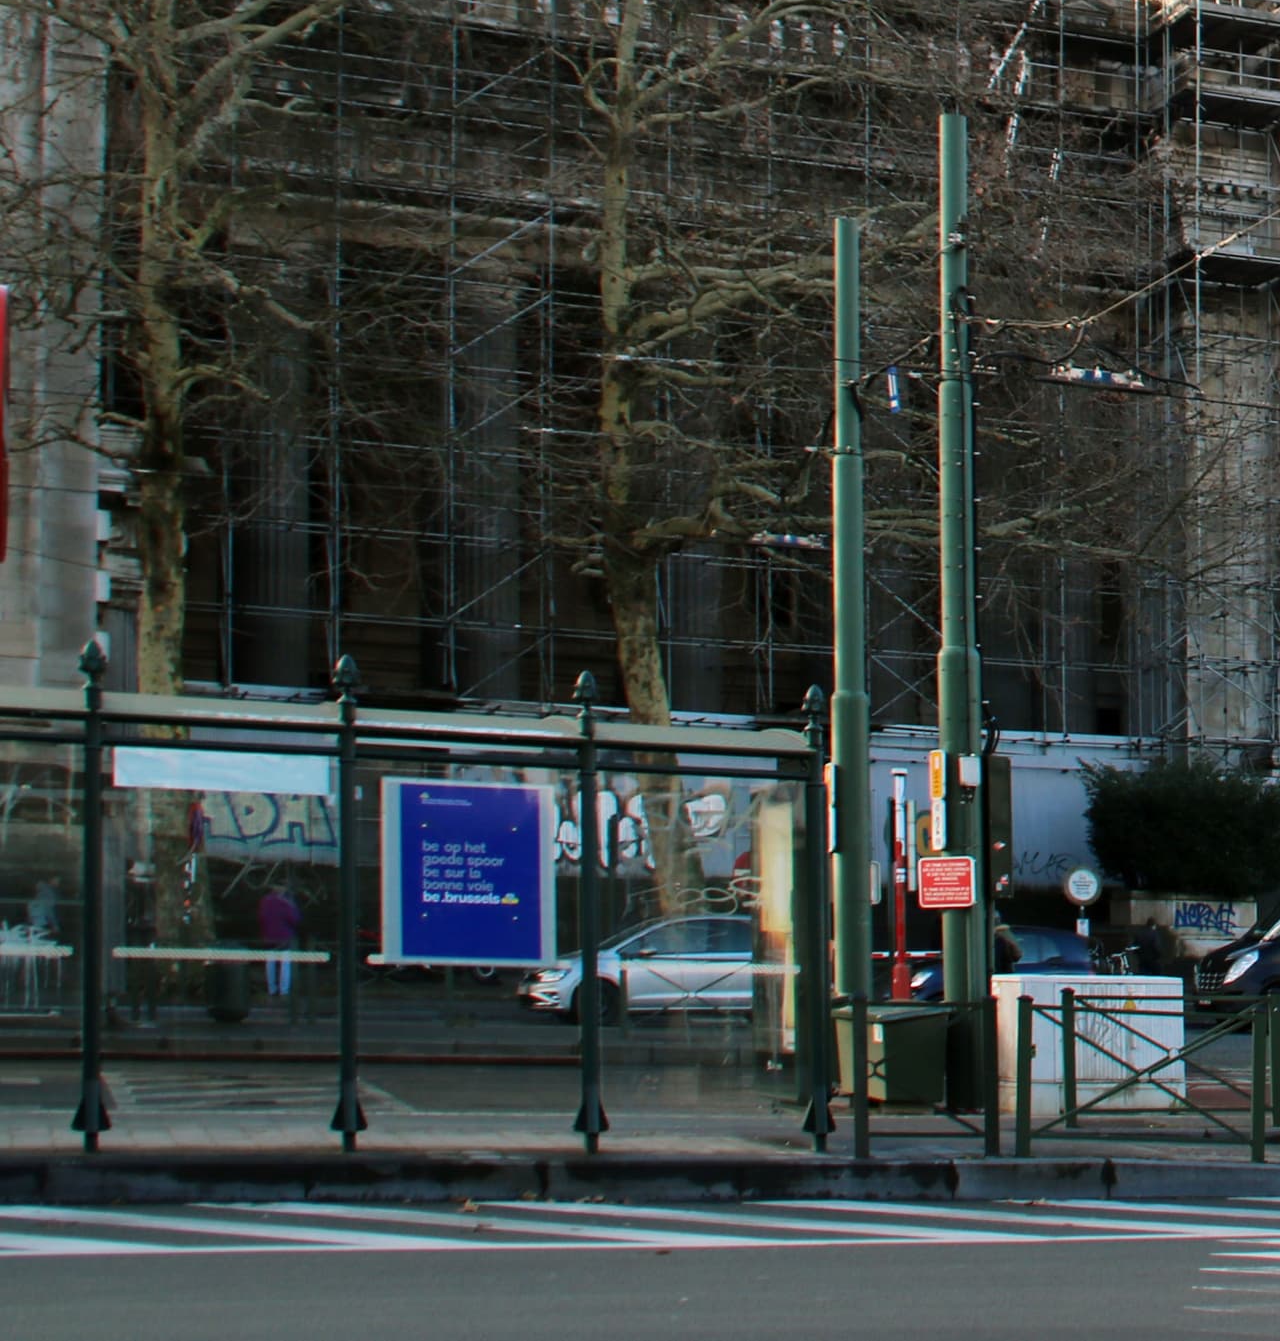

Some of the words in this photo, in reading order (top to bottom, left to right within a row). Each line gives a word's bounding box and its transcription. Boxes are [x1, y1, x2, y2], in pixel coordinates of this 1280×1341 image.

[422, 841, 439, 852] be
[444, 843, 461, 856] op
[464, 841, 486, 853] het
[423, 854, 463, 866] goede
[467, 857, 504, 867] spoor
[423, 867, 439, 878] be
[445, 869, 465, 878] sur
[469, 868, 481, 878] la
[423, 879, 463, 891] bonne
[466, 881, 494, 891] voie
[422, 891, 501, 904] be.brussels
